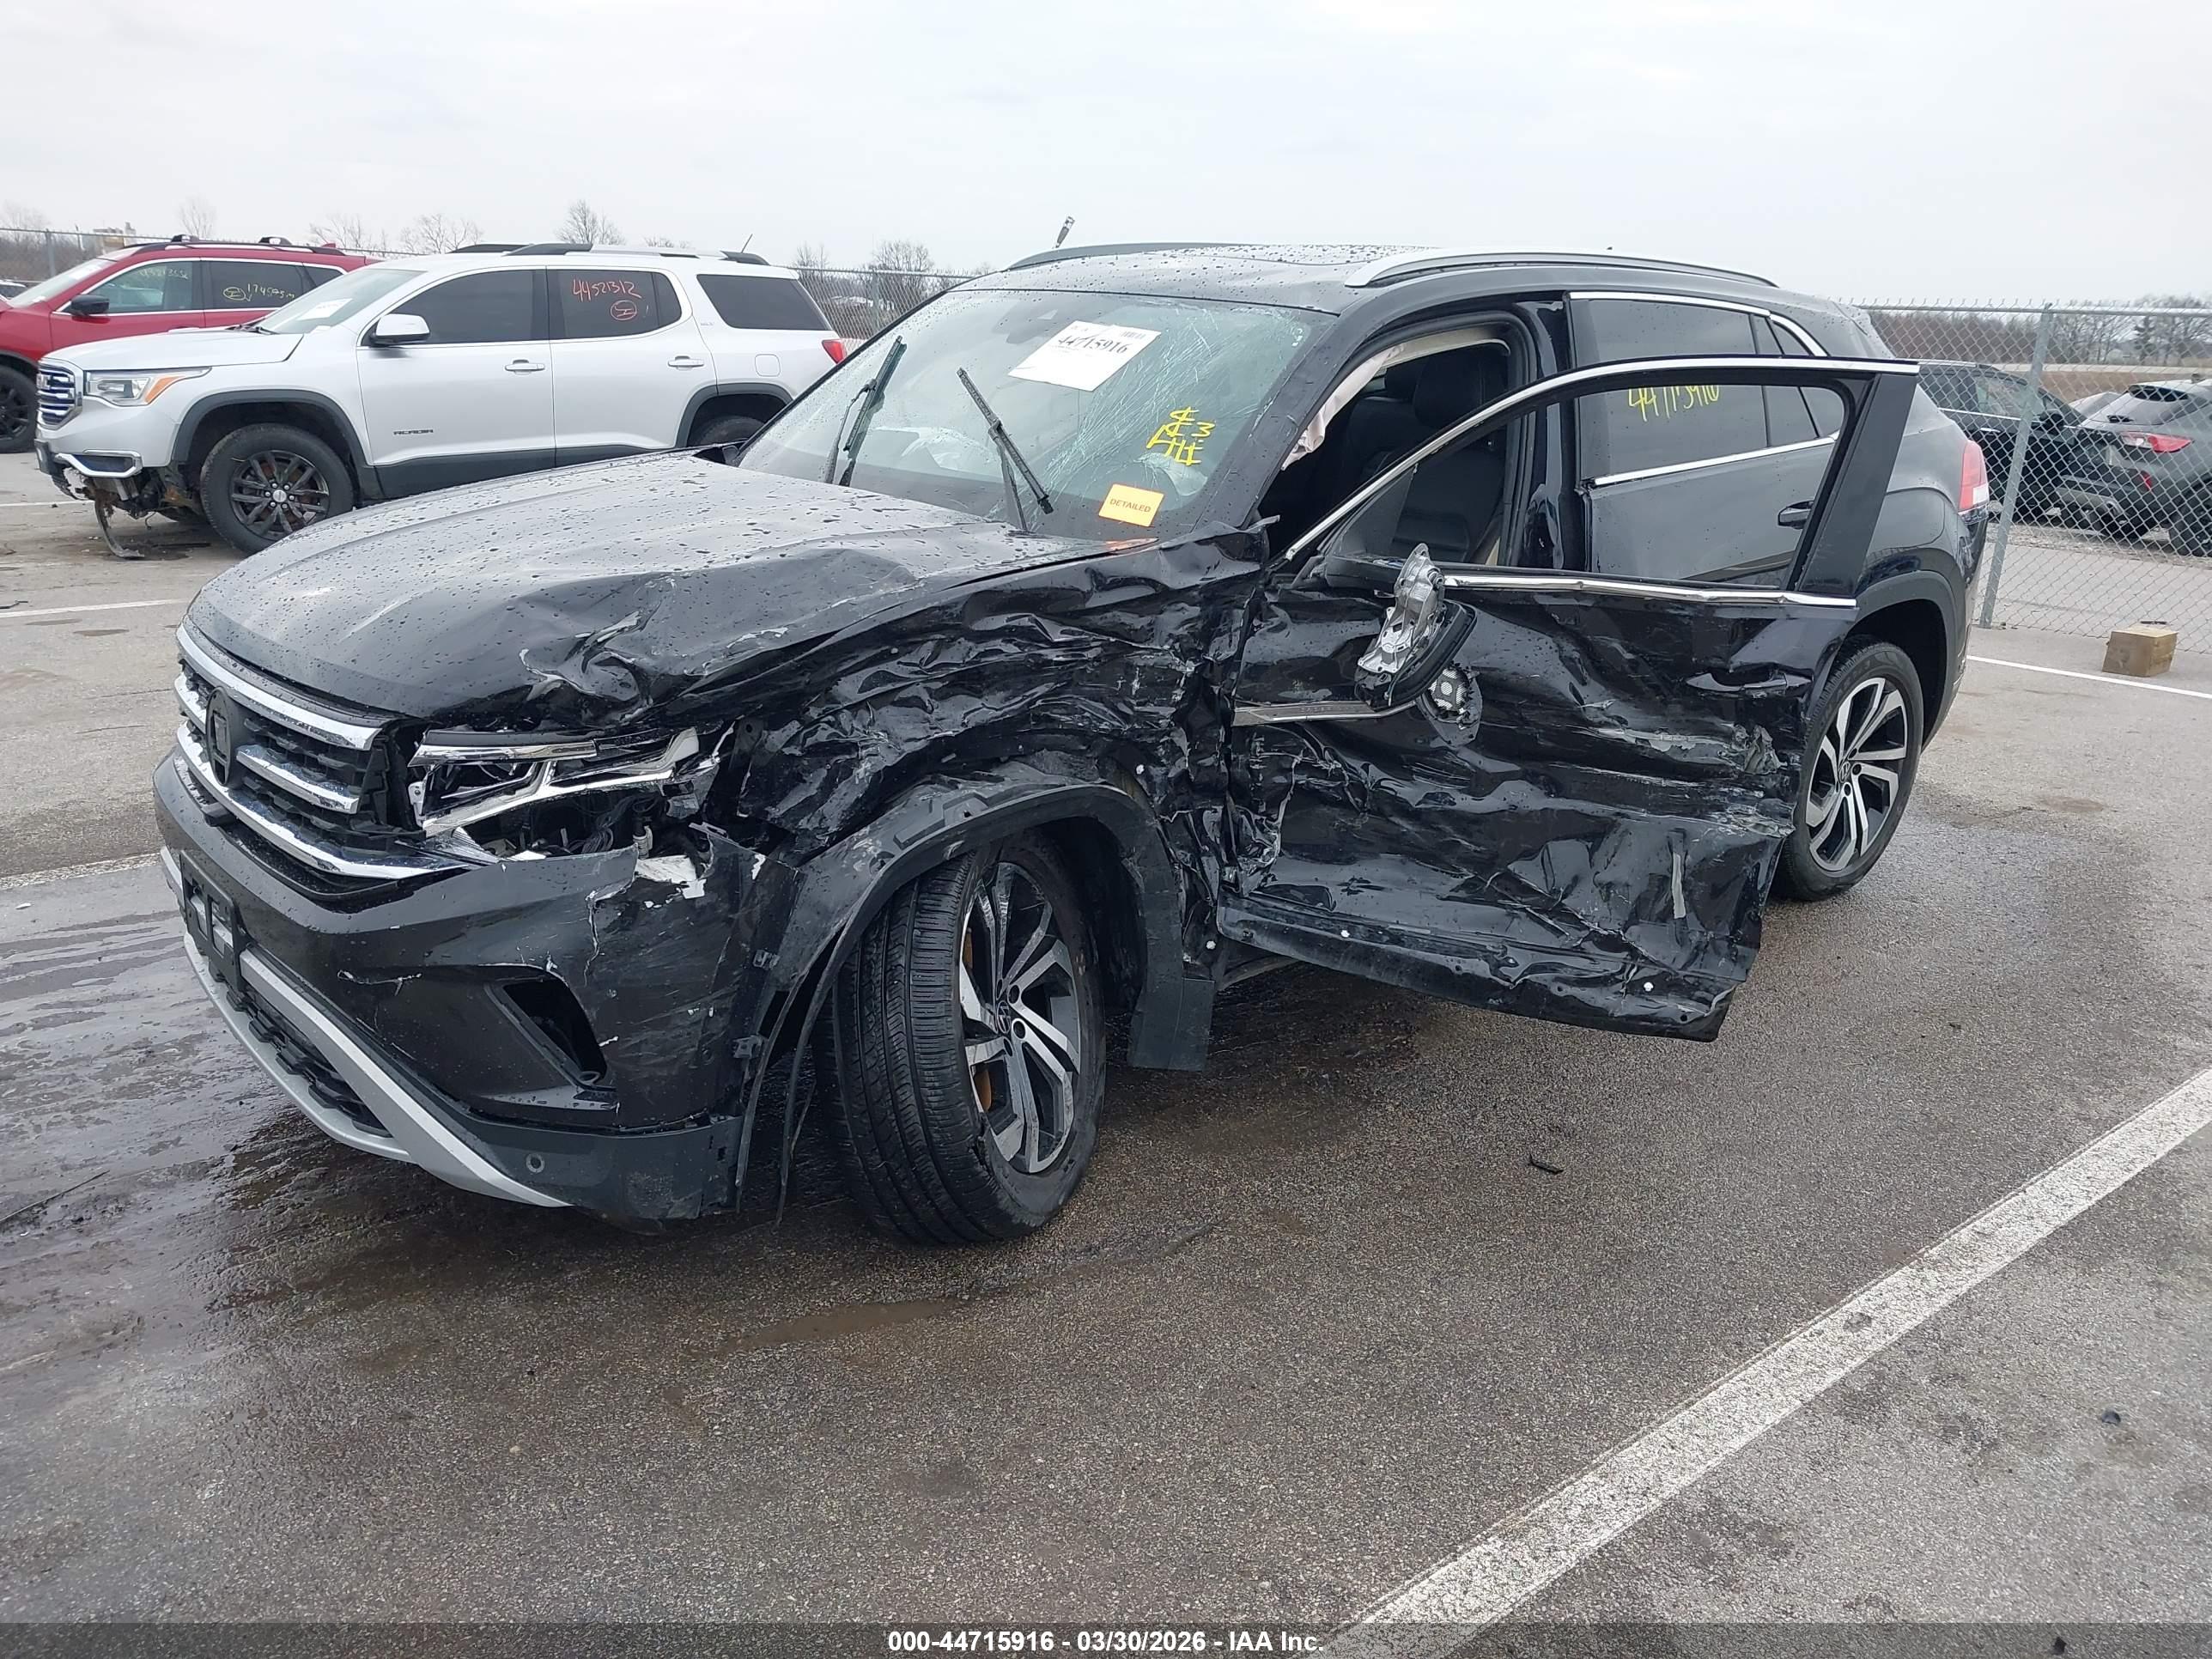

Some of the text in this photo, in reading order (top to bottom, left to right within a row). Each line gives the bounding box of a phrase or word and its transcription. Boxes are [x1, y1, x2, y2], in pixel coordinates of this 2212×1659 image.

[573, 279, 641, 302] 44521312
[1058, 334, 1132, 354] 44715916
[1109, 498, 1152, 514] DETAILED
